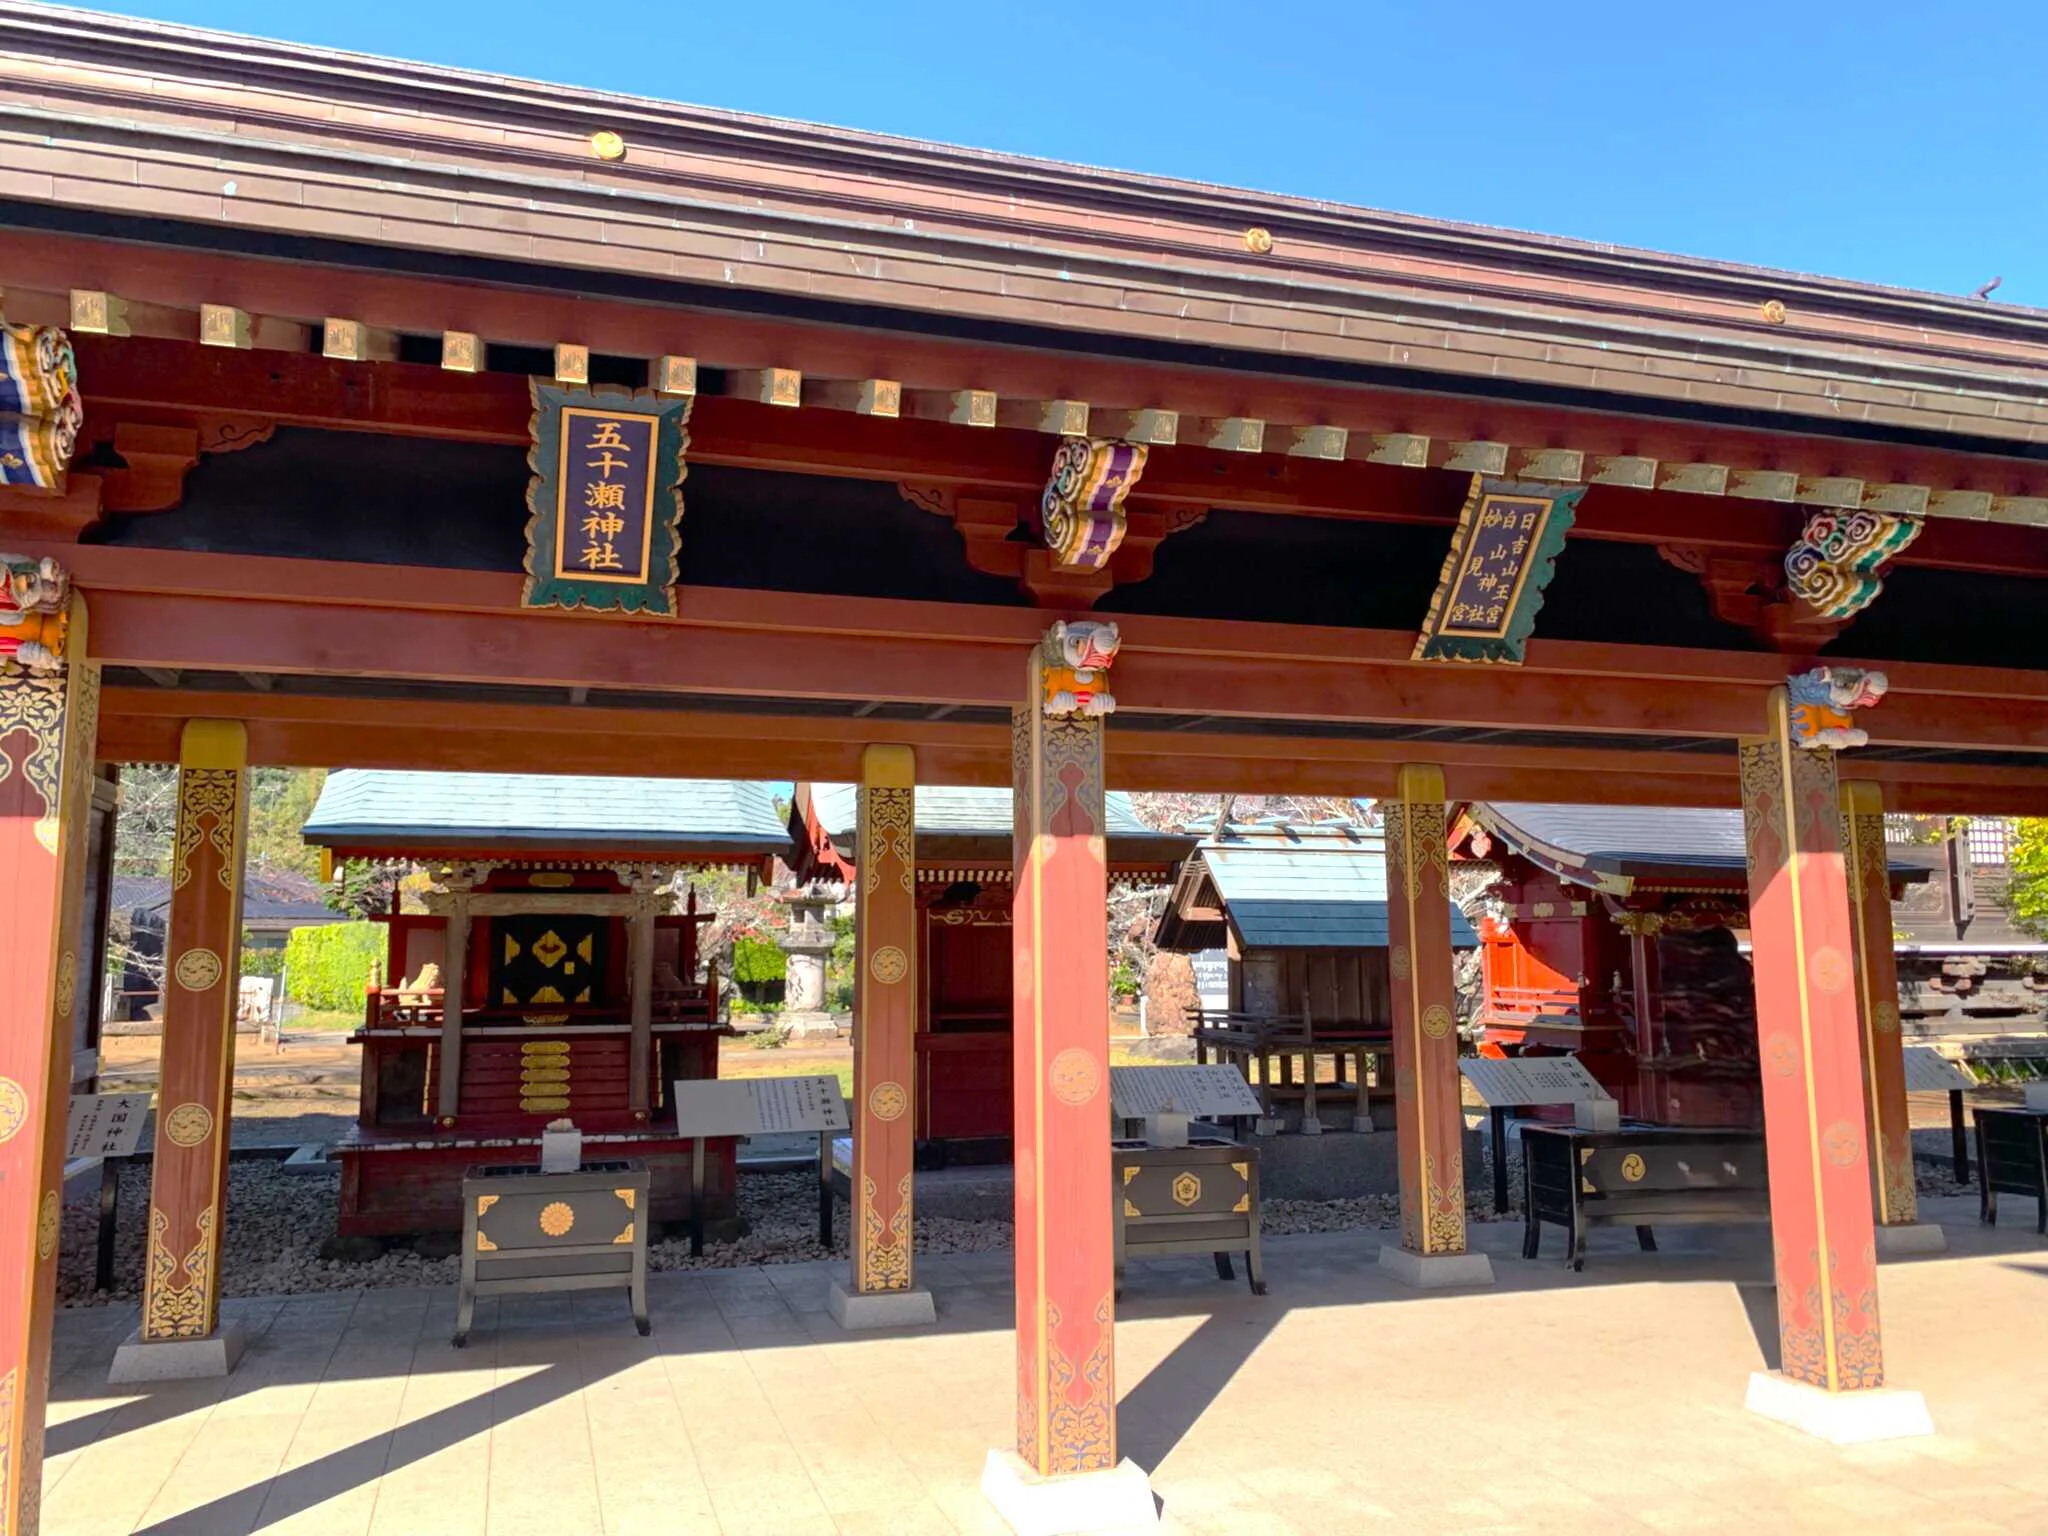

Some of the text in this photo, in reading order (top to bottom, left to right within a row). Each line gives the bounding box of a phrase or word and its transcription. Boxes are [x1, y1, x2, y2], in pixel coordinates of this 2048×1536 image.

[578, 421, 631, 571] 五十瀬神社
[1451, 508, 1503, 622] 妙見宮
[1466, 510, 1517, 623] 白山神社
[1486, 512, 1537, 624] 日吉山王宮
[102, 1098, 131, 1153] 大国神社
